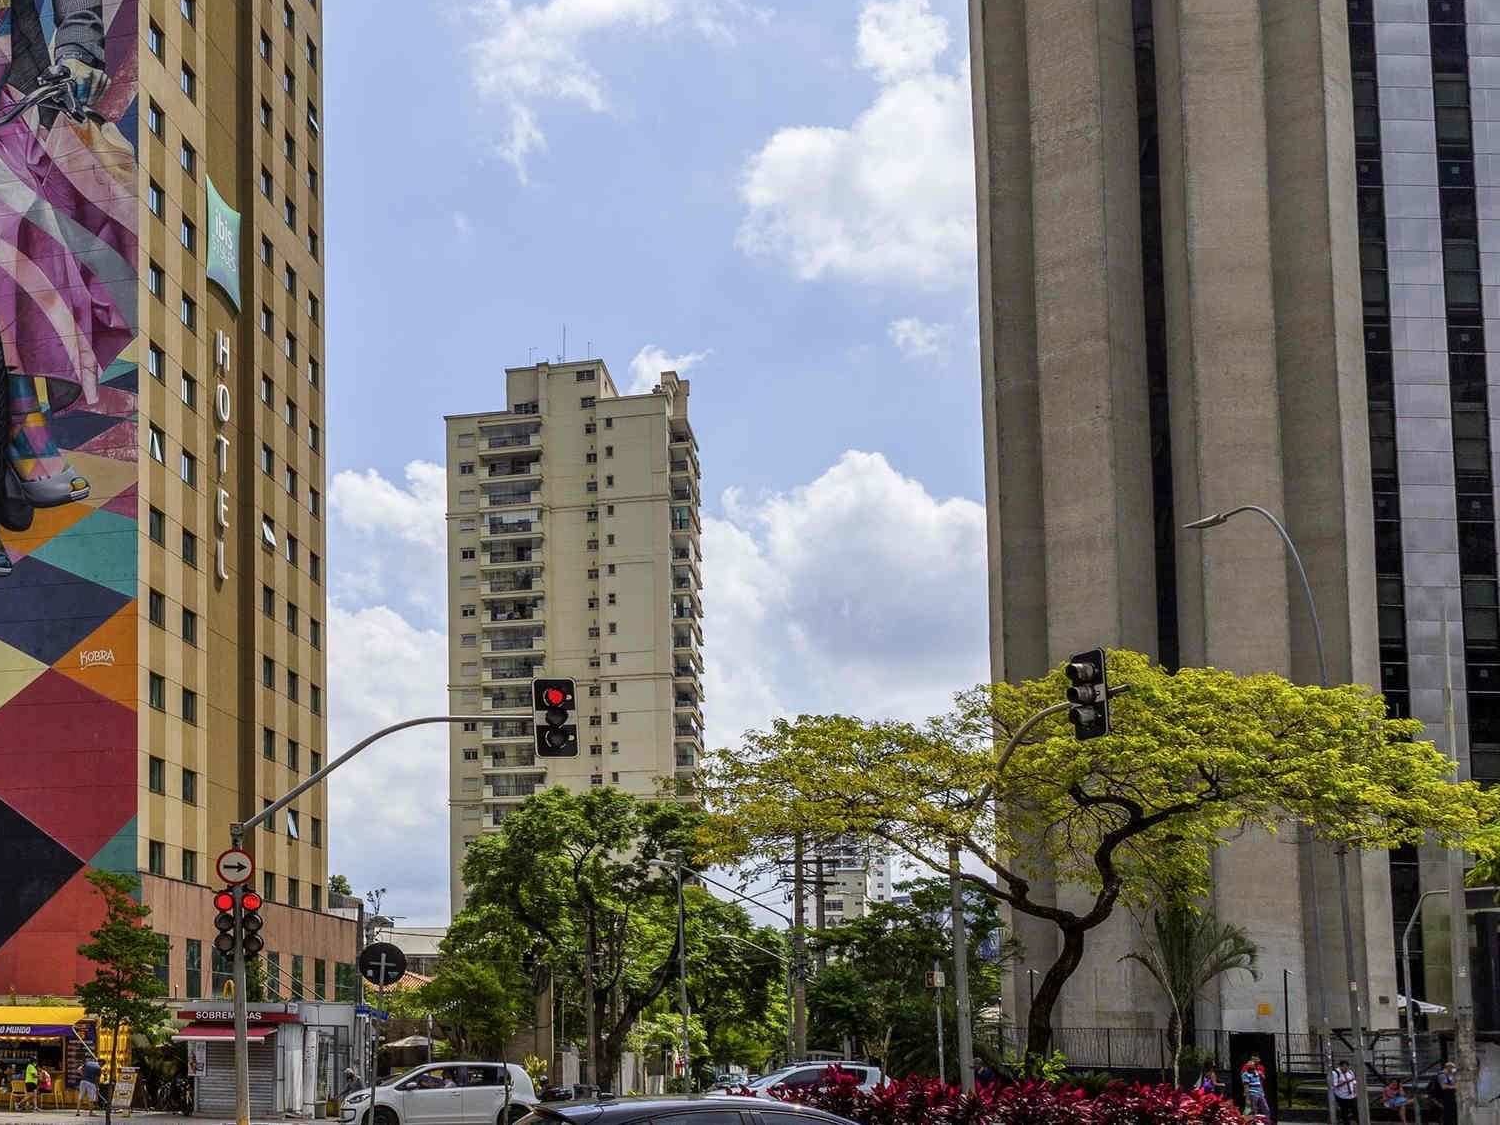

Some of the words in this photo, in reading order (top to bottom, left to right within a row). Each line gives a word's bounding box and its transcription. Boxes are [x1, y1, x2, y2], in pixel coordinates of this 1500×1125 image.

[214, 208, 233, 250] ibis
[215, 329, 231, 581] HOTEL
[79, 649, 116, 667] KOBRA
[196, 1010, 262, 1020] SOBREMAS
[5, 1026, 31, 1034] MUNDO
